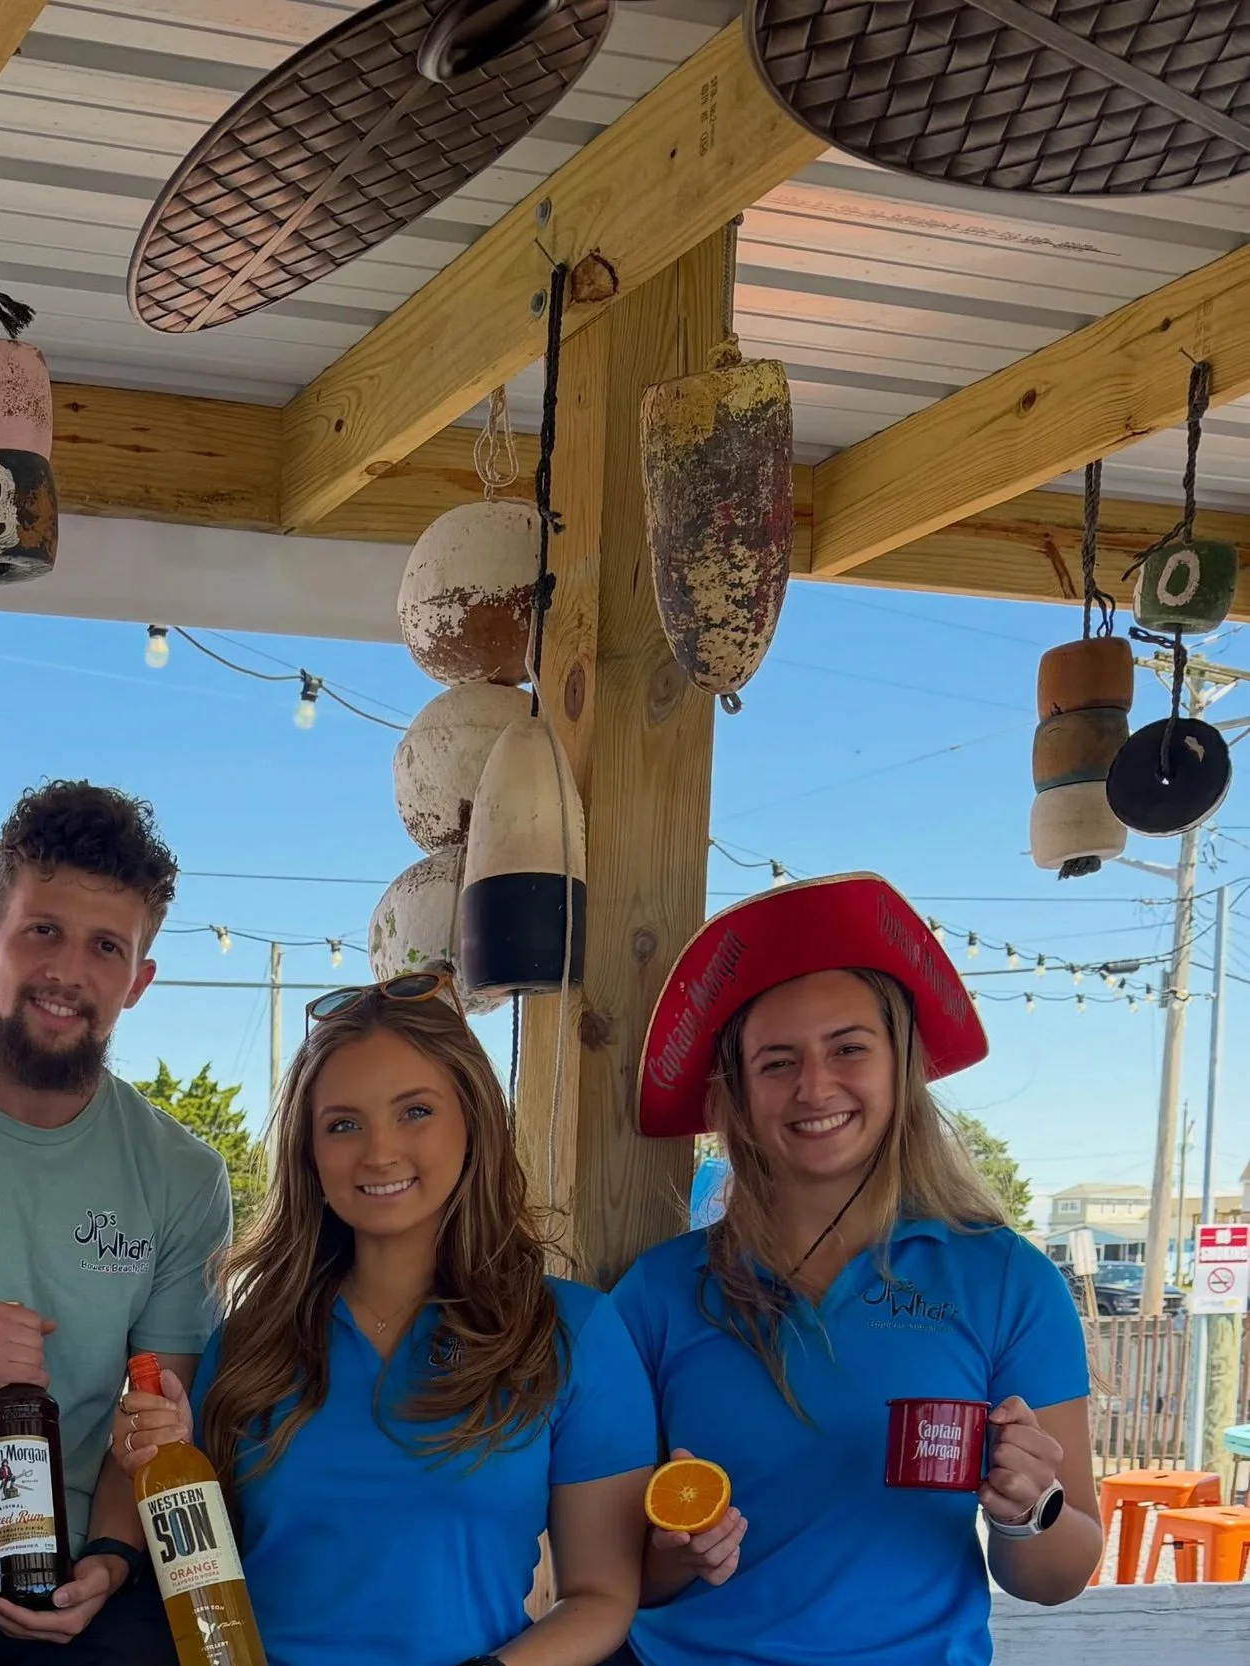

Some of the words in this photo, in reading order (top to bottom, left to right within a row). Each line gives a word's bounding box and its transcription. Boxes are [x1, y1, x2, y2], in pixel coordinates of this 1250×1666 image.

[686, 928, 749, 1020] Morgan
[918, 1419, 962, 1441] Captain
[2, 1444, 48, 1464] Morgan
[912, 1440, 961, 1461] Morgan
[148, 1487, 205, 1516] WESTERN
[15, 1510, 45, 1525] Rum
[151, 1501, 218, 1564] SON
[170, 1560, 219, 1581] ORANGE
